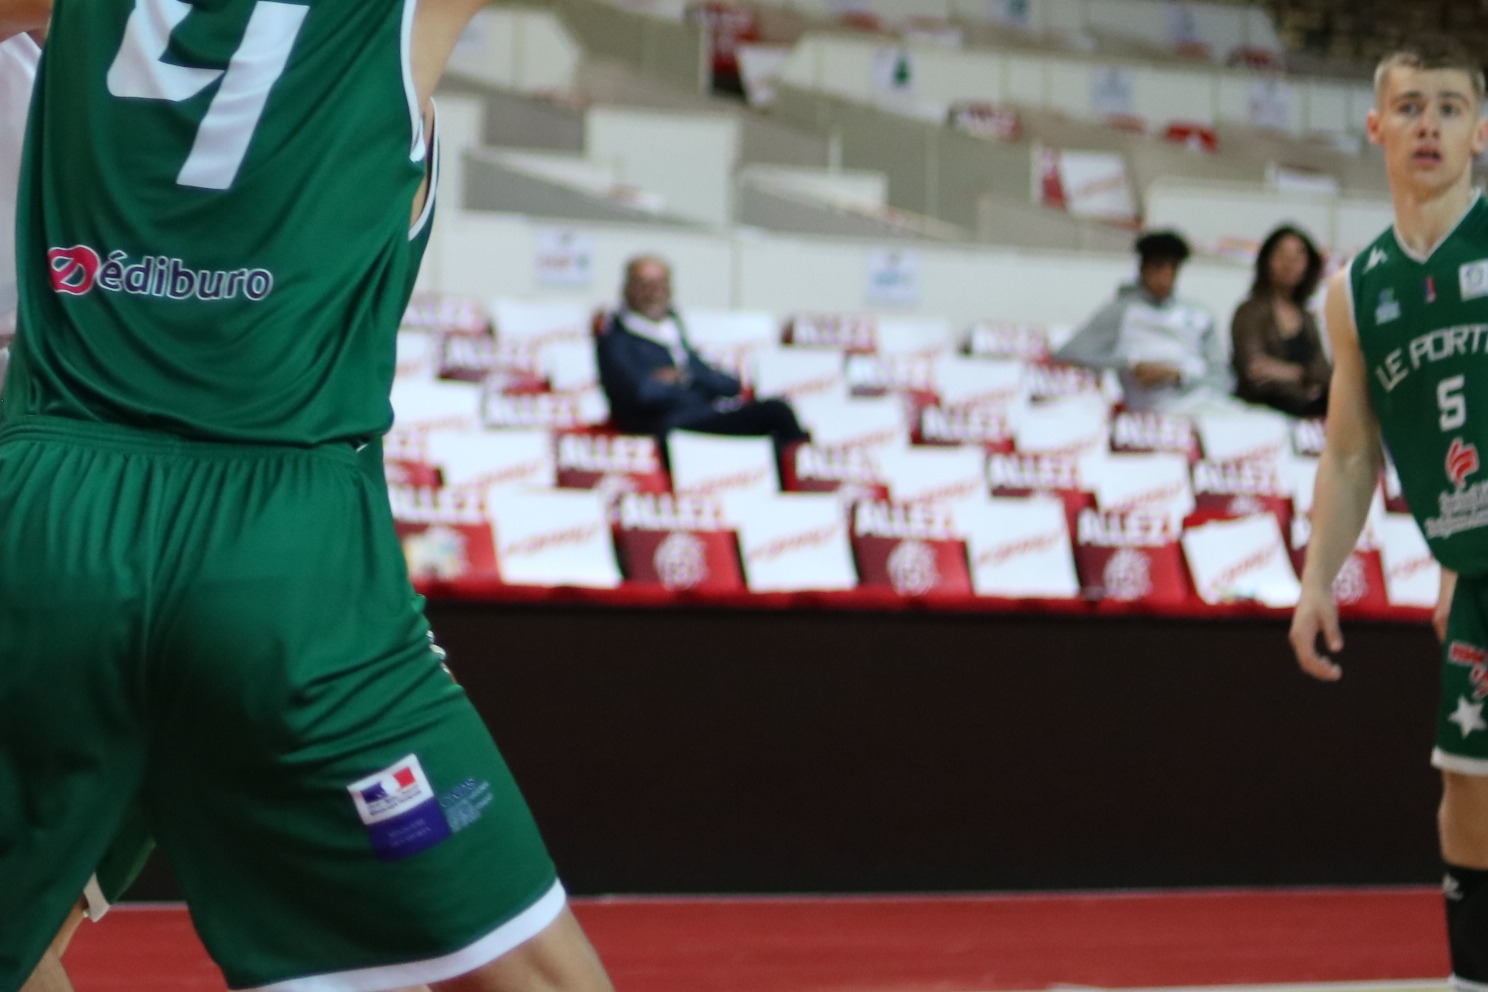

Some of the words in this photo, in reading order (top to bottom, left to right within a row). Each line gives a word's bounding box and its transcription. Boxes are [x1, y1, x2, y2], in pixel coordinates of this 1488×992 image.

[1375, 347, 1408, 392] LE
[1409, 323, 1488, 368] PORT
[1436, 374, 1466, 432] 5
